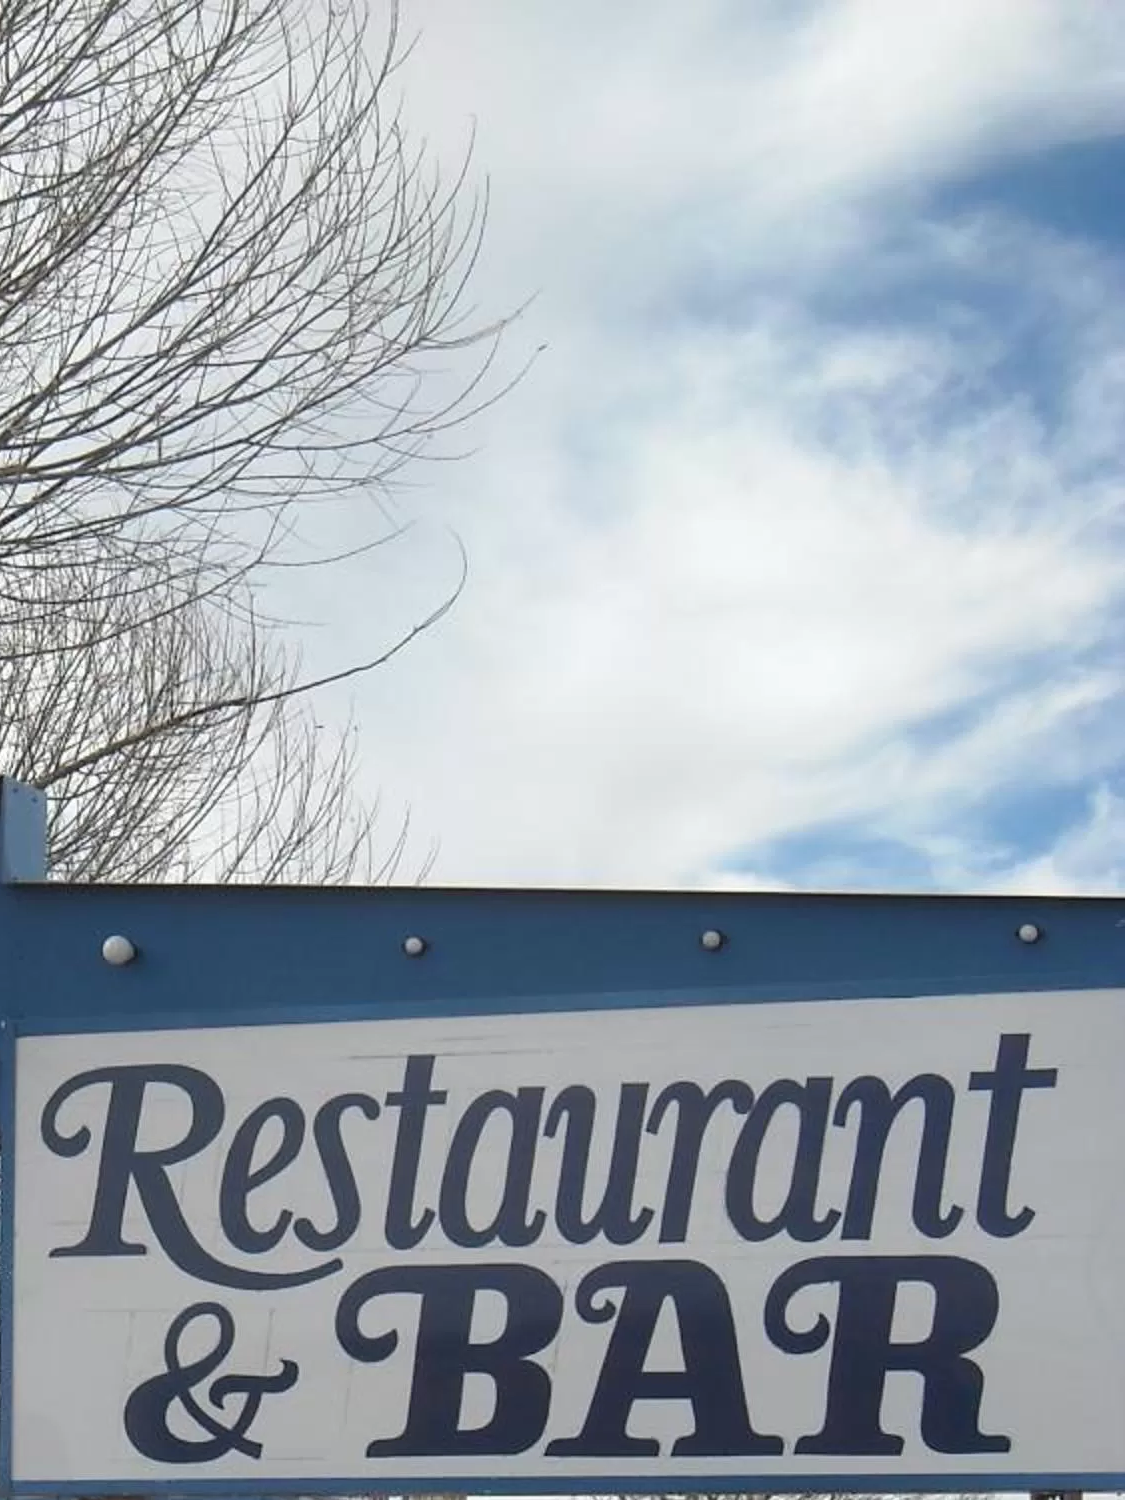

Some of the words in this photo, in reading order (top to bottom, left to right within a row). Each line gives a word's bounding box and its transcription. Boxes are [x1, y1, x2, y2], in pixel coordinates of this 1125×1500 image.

[40, 1032, 1059, 1291] Restaurant
[123, 1301, 300, 1465] &
[334, 1254, 1013, 1459] BAR
